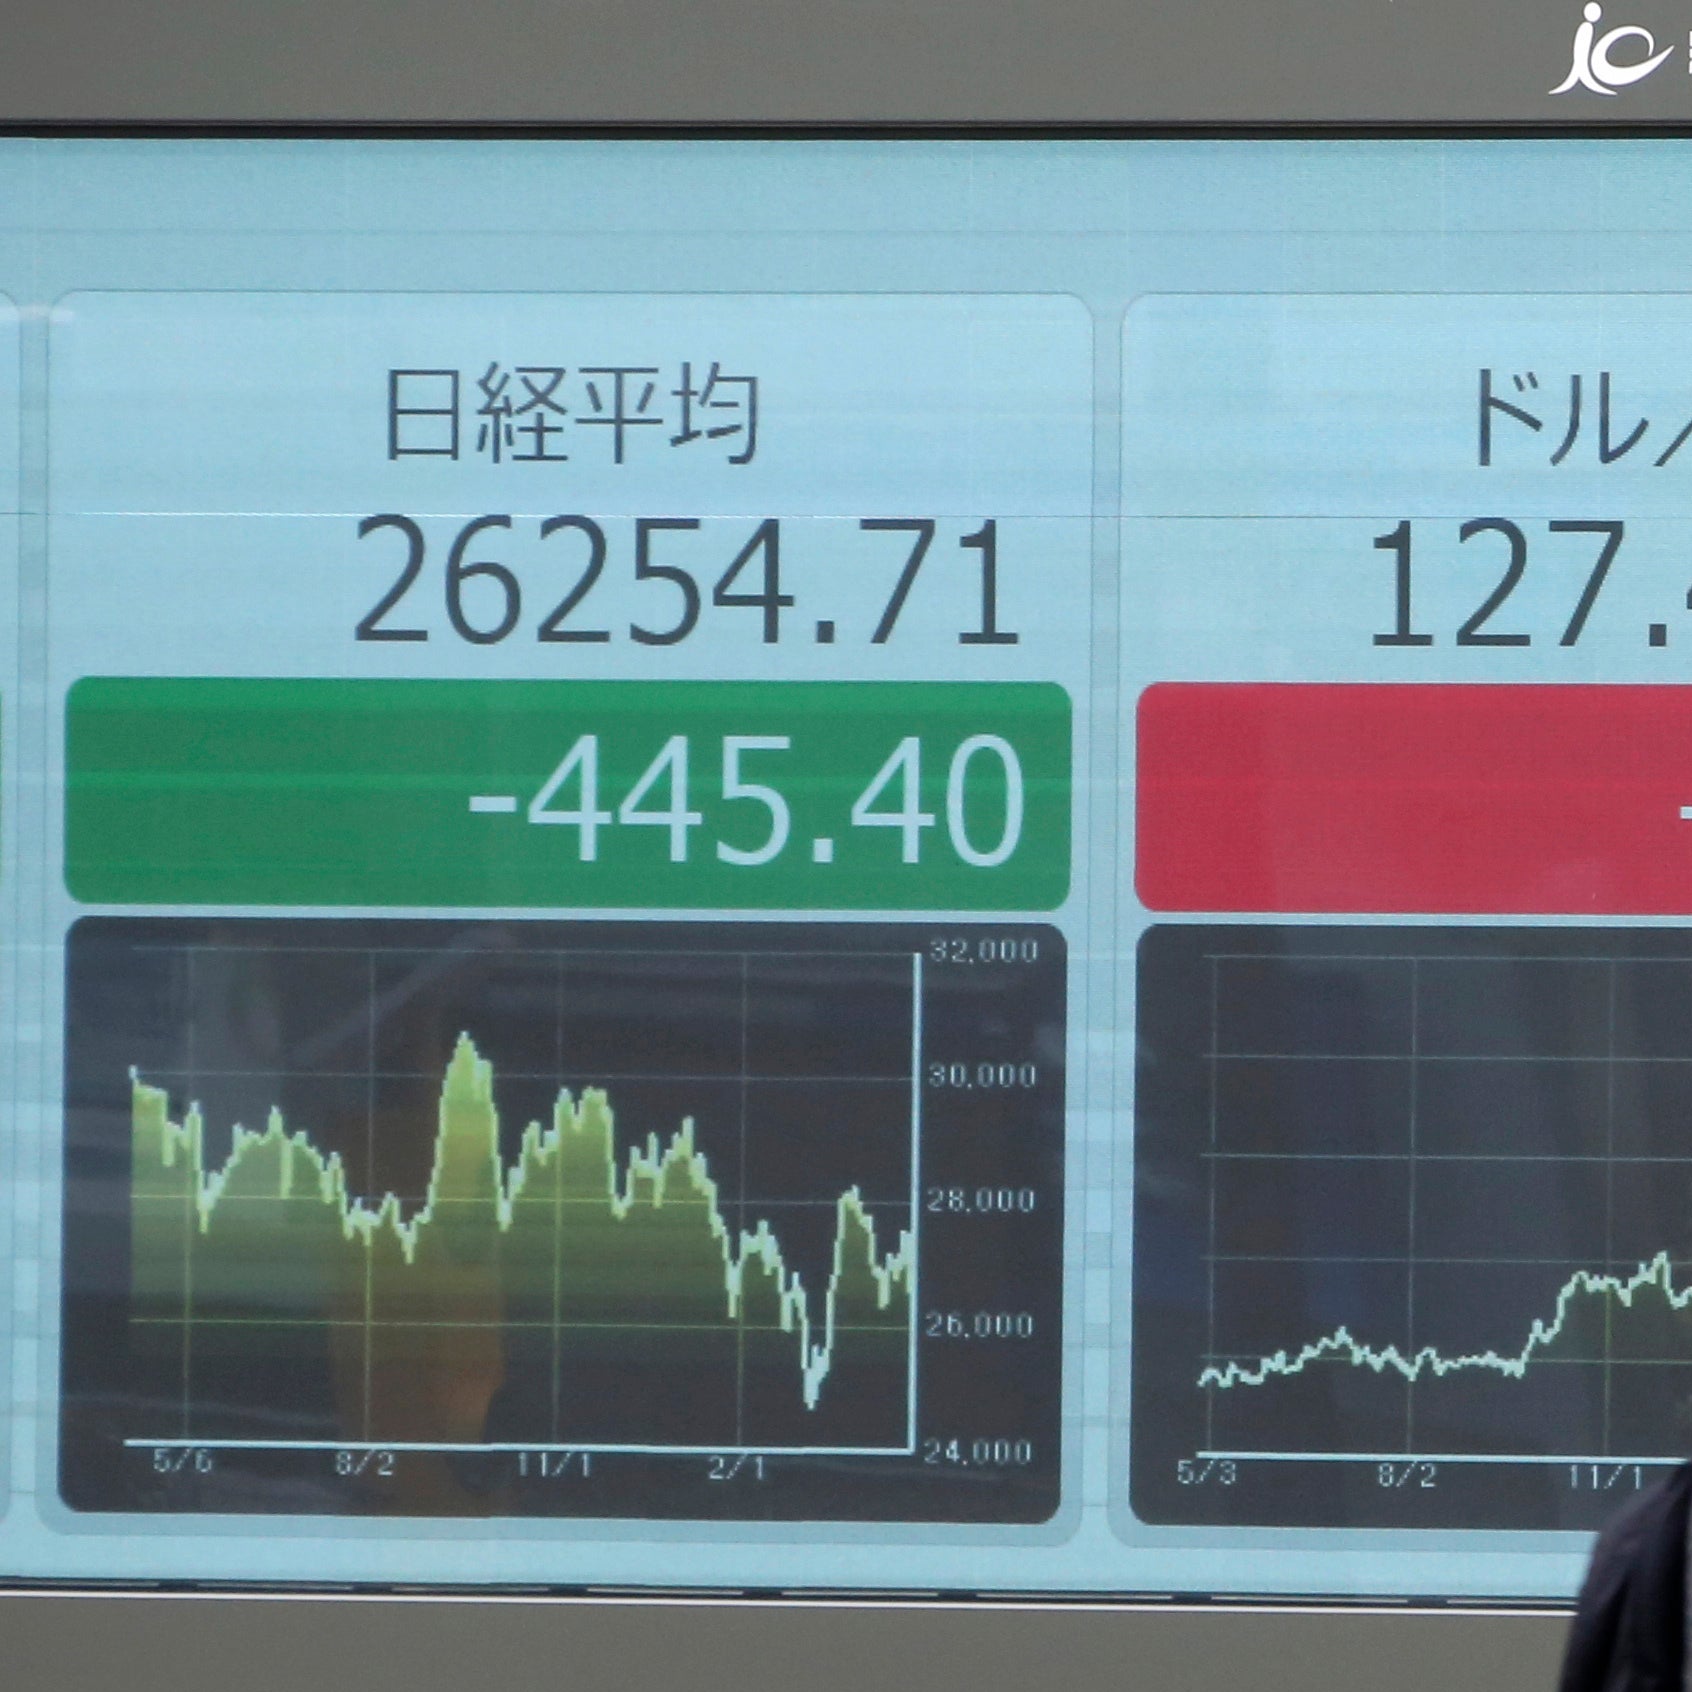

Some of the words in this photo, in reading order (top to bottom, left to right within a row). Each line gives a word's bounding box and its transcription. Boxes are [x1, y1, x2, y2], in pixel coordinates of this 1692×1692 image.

[386, 362, 760, 466] 日経平均
[354, 513, 1020, 647] 26254.71
[468, 734, 1024, 868] -445.40
[335, 1449, 396, 1476] 8/2
[518, 1451, 591, 1478] 11/1
[708, 1453, 764, 1481] 2/1
[1177, 1459, 1237, 1486] 5/3
[1378, 1461, 1437, 1488] 8/2
[1569, 1463, 1643, 1490] 11/1
